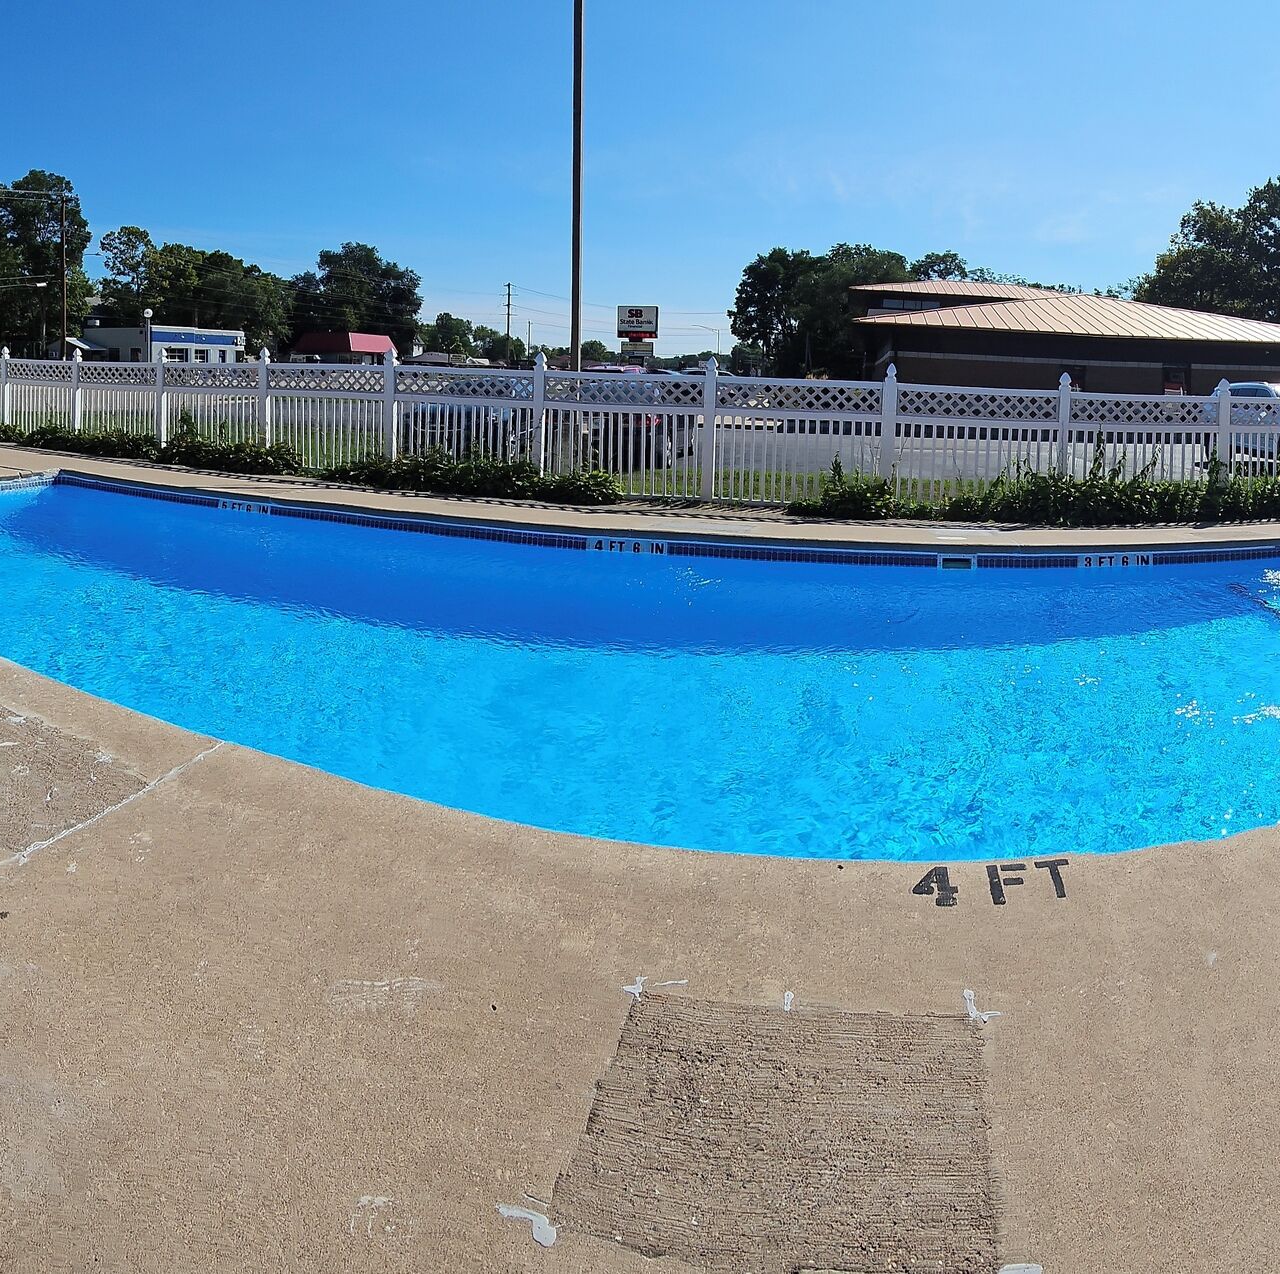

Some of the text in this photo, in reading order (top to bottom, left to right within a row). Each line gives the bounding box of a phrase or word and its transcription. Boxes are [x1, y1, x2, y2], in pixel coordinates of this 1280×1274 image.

[627, 308, 643, 318] SB
[222, 501, 228, 509] 5
[231, 502, 243, 511] FT
[259, 505, 269, 514] IN
[594, 540, 664, 554] 4 FT 6 IN
[1084, 554, 1150, 567] 3 FT 6 IN
[911, 857, 1070, 908] 4 FT
